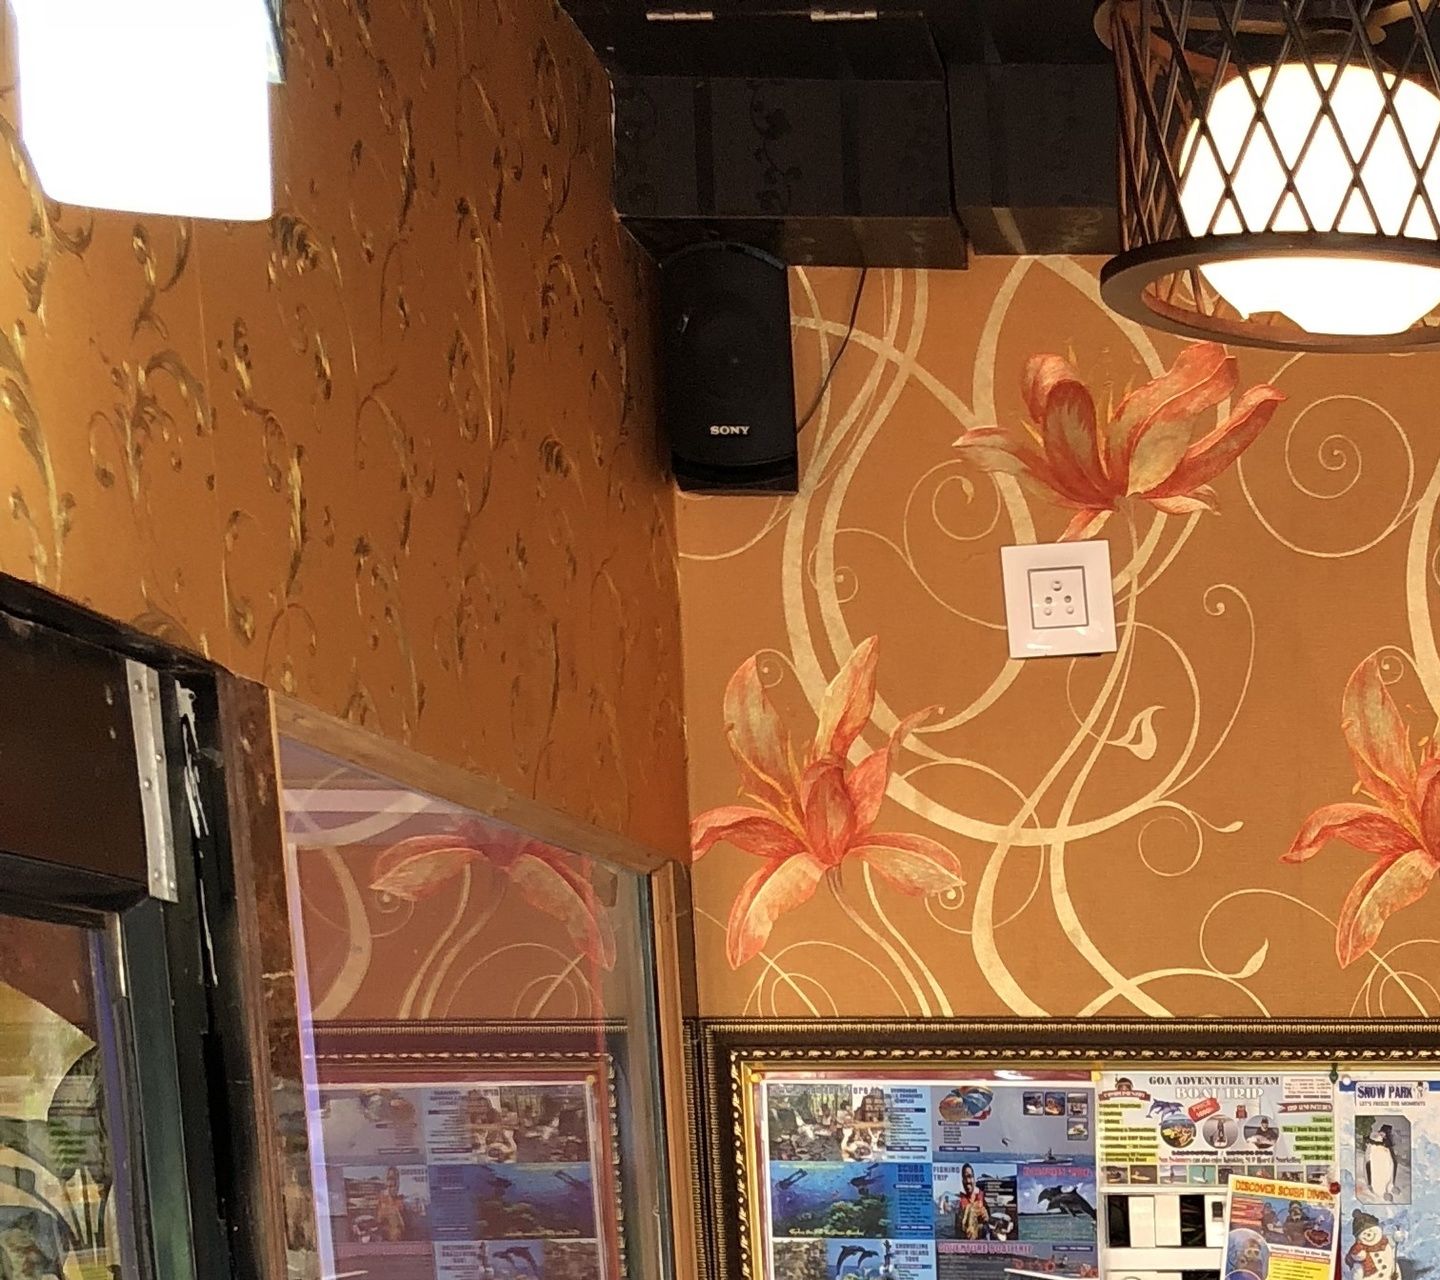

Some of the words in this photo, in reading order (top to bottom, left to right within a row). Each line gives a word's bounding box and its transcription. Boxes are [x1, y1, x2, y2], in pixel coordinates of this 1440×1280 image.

[710, 425, 750, 435] SONY
[1149, 1076, 1173, 1086] GOA
[1175, 1076, 1246, 1086] ADVENTURE
[1249, 1076, 1280, 1086] TEAM
[1224, 1087, 1264, 1099] TRIP
[1357, 1085, 1387, 1100] SNOW
[1388, 1086, 1413, 1100] PARK
